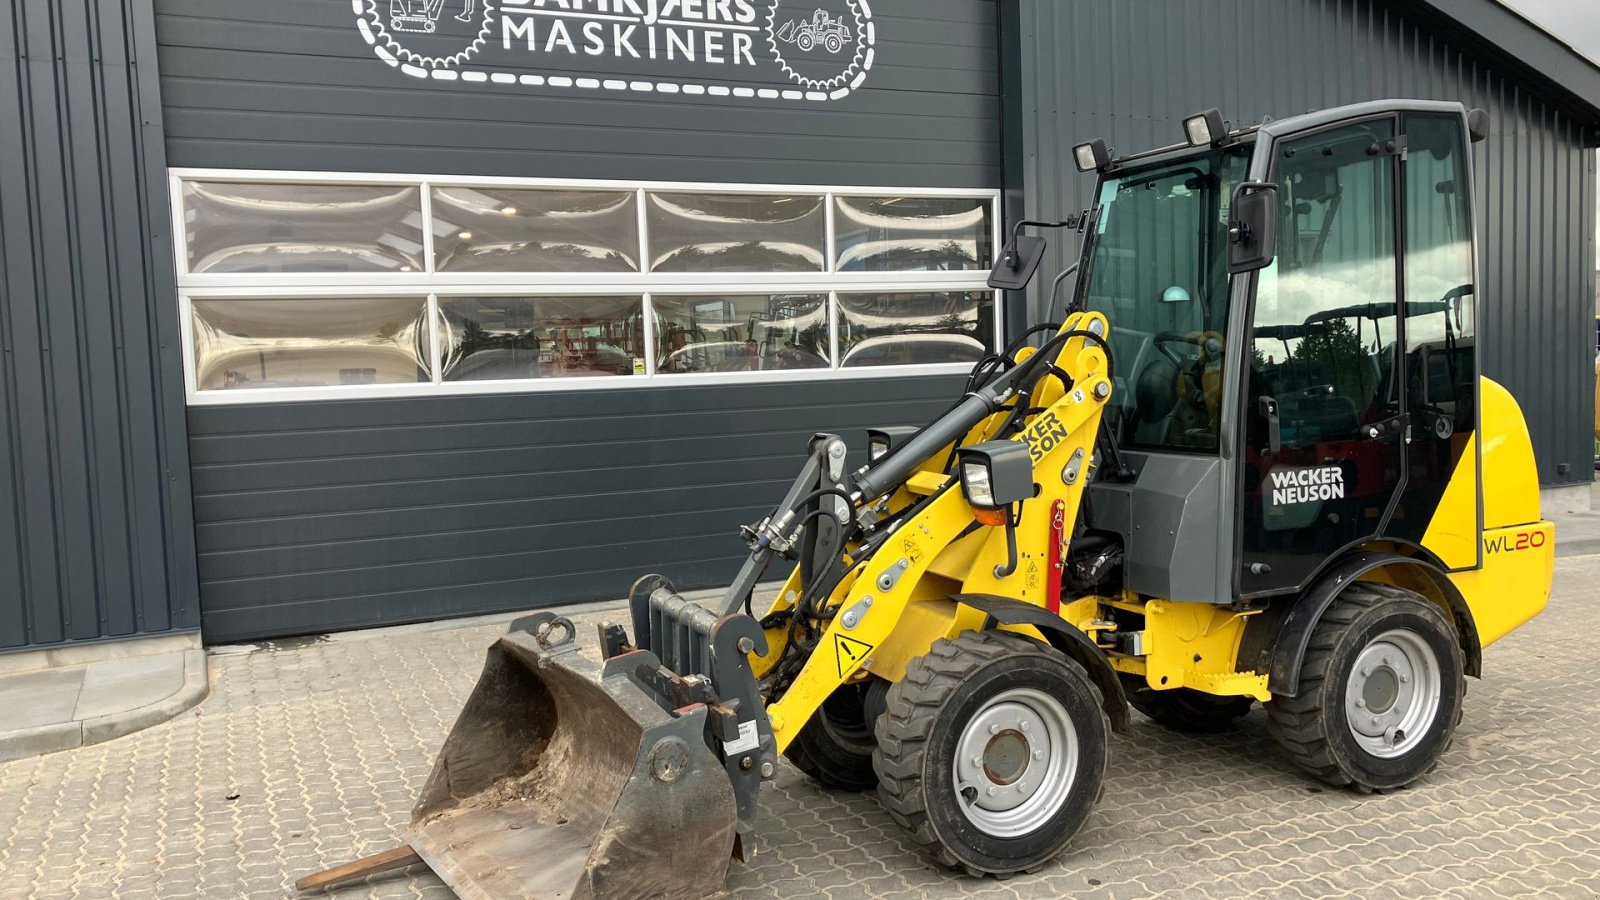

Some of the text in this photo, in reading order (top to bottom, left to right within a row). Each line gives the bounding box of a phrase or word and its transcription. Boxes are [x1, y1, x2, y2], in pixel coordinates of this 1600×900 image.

[502, 0, 756, 24] JÆRS
[501, 15, 757, 66] MASKINER
[1020, 412, 1060, 447] KER
[1030, 423, 1068, 463] SON
[1271, 467, 1344, 489] WACKER
[1273, 483, 1344, 505] NEUSON
[1484, 531, 1545, 554] WL20
